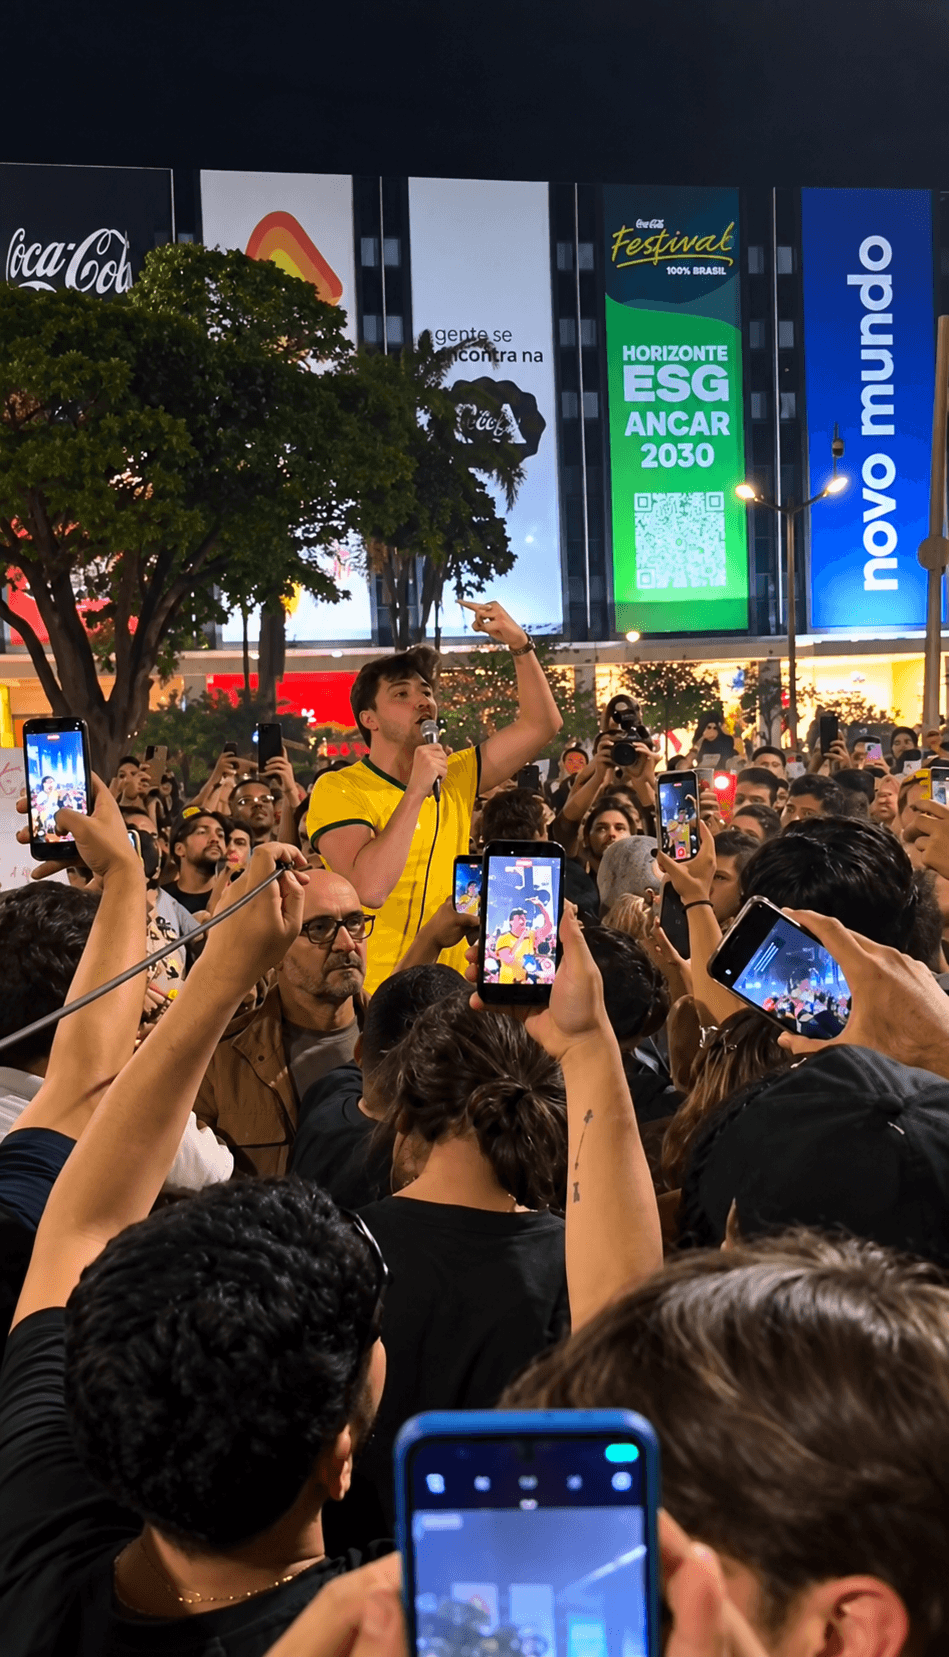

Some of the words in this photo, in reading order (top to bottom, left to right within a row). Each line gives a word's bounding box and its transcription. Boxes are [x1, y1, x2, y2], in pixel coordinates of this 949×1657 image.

[611, 221, 735, 266] Festival
[666, 266, 691, 275] 100%
[692, 266, 727, 275] BRASIL
[435, 327, 489, 345] gente
[492, 330, 512, 342] se
[846, 235, 895, 435] mundo
[522, 351, 543, 362] na
[622, 345, 729, 361] HORIZONTE
[623, 364, 729, 402] ESG
[624, 411, 731, 436] ANCAR
[641, 442, 715, 468] 2030
[862, 453, 899, 591] novo
